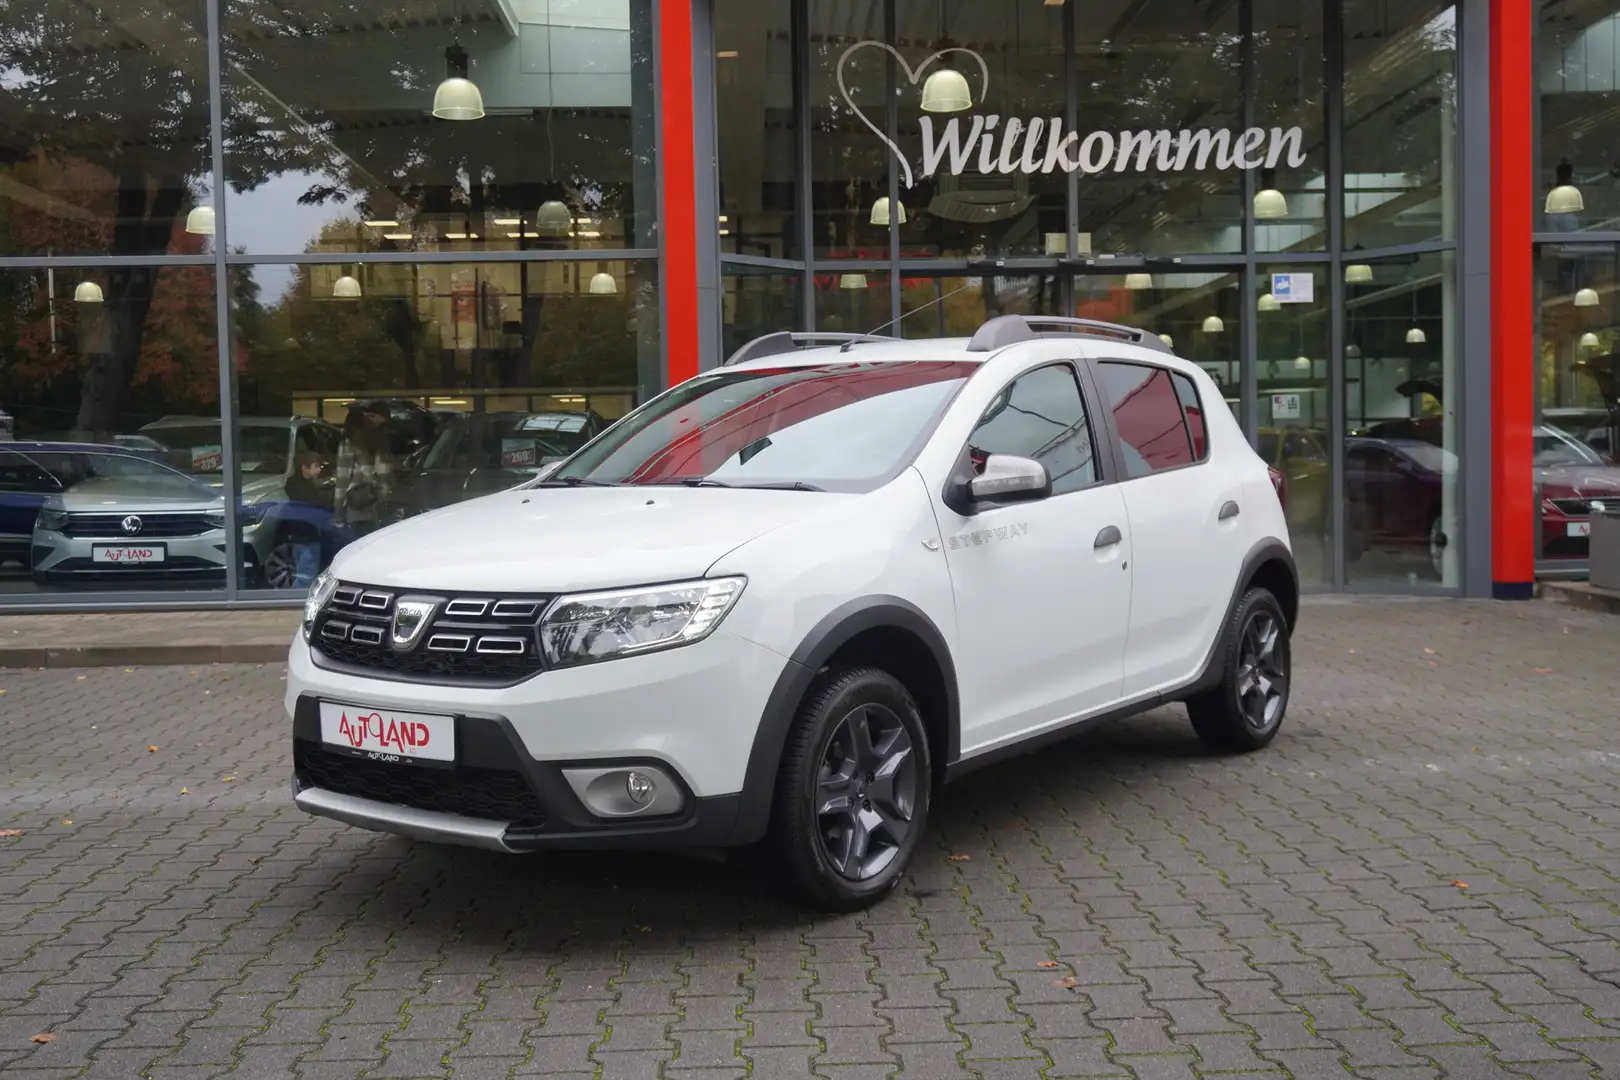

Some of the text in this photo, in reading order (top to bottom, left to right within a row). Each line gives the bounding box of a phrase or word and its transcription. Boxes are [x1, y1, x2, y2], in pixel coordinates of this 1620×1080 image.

[918, 114, 1307, 177] Willkommen
[948, 522, 1029, 551] STEPWAY
[399, 607, 422, 616] DACIA
[339, 710, 430, 753] AUTOLAND
